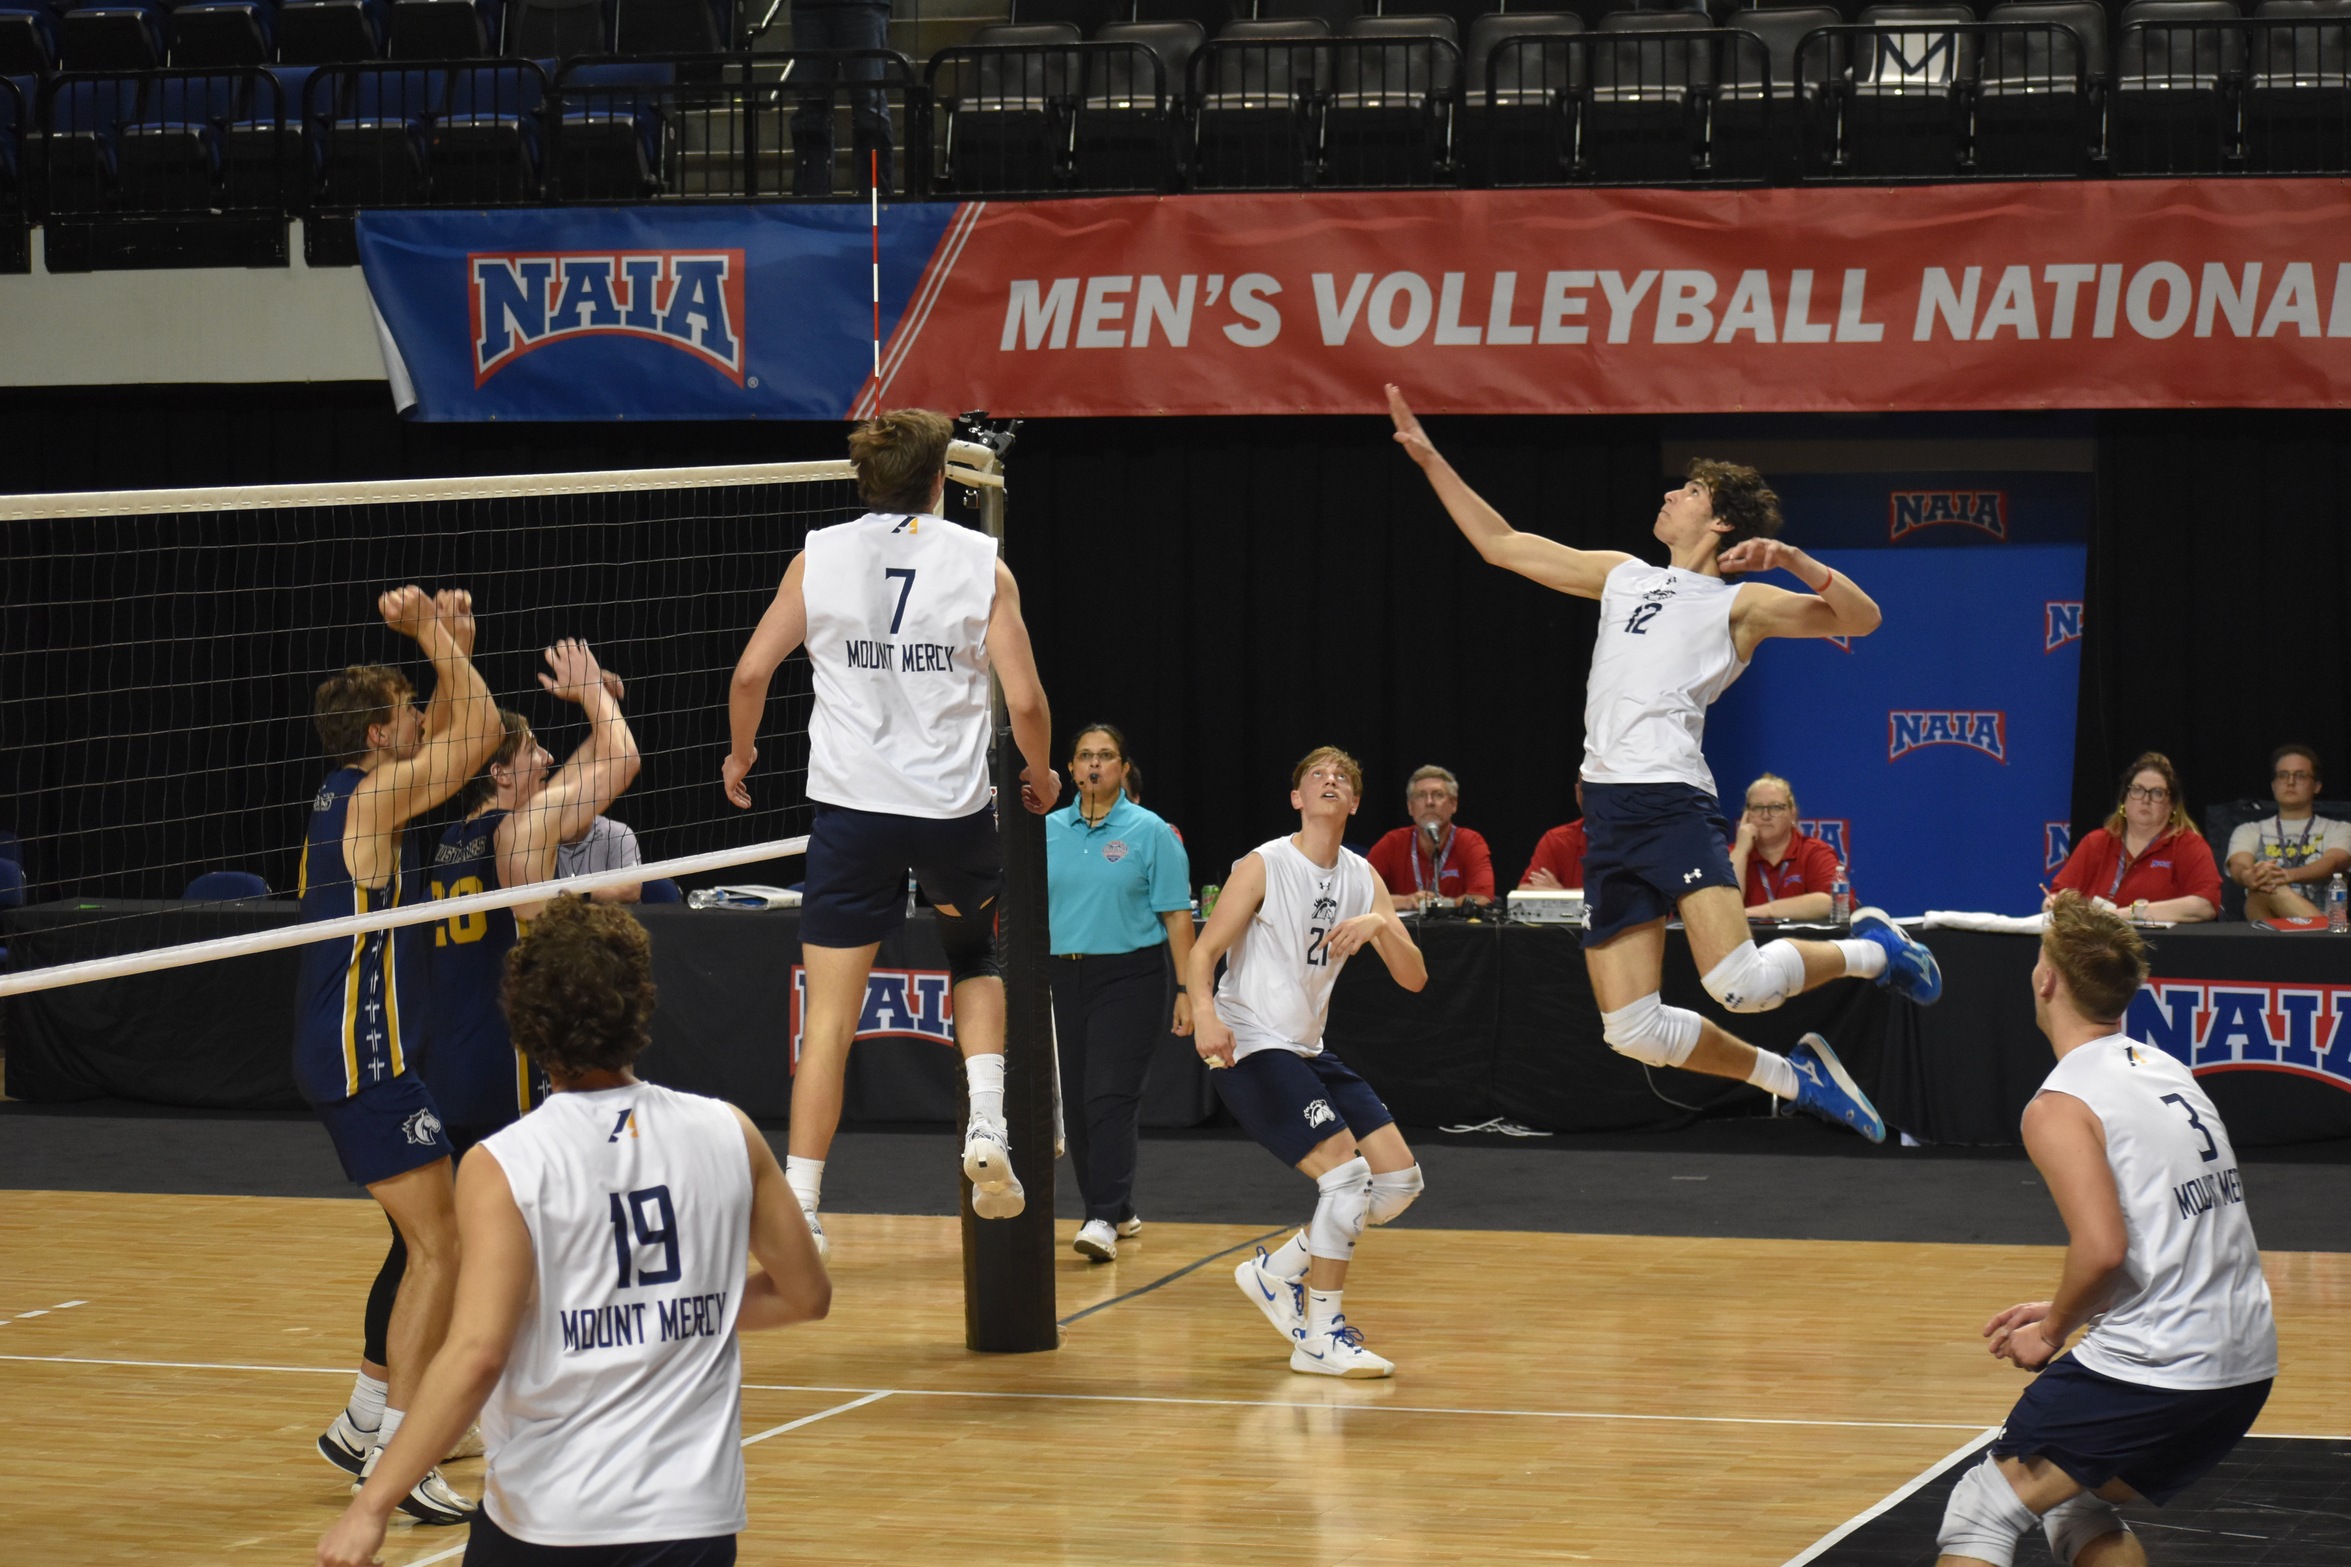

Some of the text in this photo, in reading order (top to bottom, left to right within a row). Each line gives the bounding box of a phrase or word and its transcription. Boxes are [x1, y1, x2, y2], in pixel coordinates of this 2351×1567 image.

[473, 254, 739, 375] NAIA
[1000, 272, 1283, 351] MEN'S
[1311, 268, 1885, 348] VOLLEYBALL
[1891, 491, 2004, 539] NAIA
[885, 567, 916, 635] 7
[1624, 602, 1663, 635] 12
[846, 640, 955, 673] MOUNT MERCY
[1890, 712, 2004, 761] NAIA
[1307, 926, 1332, 967] 21
[2159, 1092, 2219, 1163] 3
[609, 1184, 682, 1289] 19
[560, 1292, 727, 1351] MOUNT MERCY
